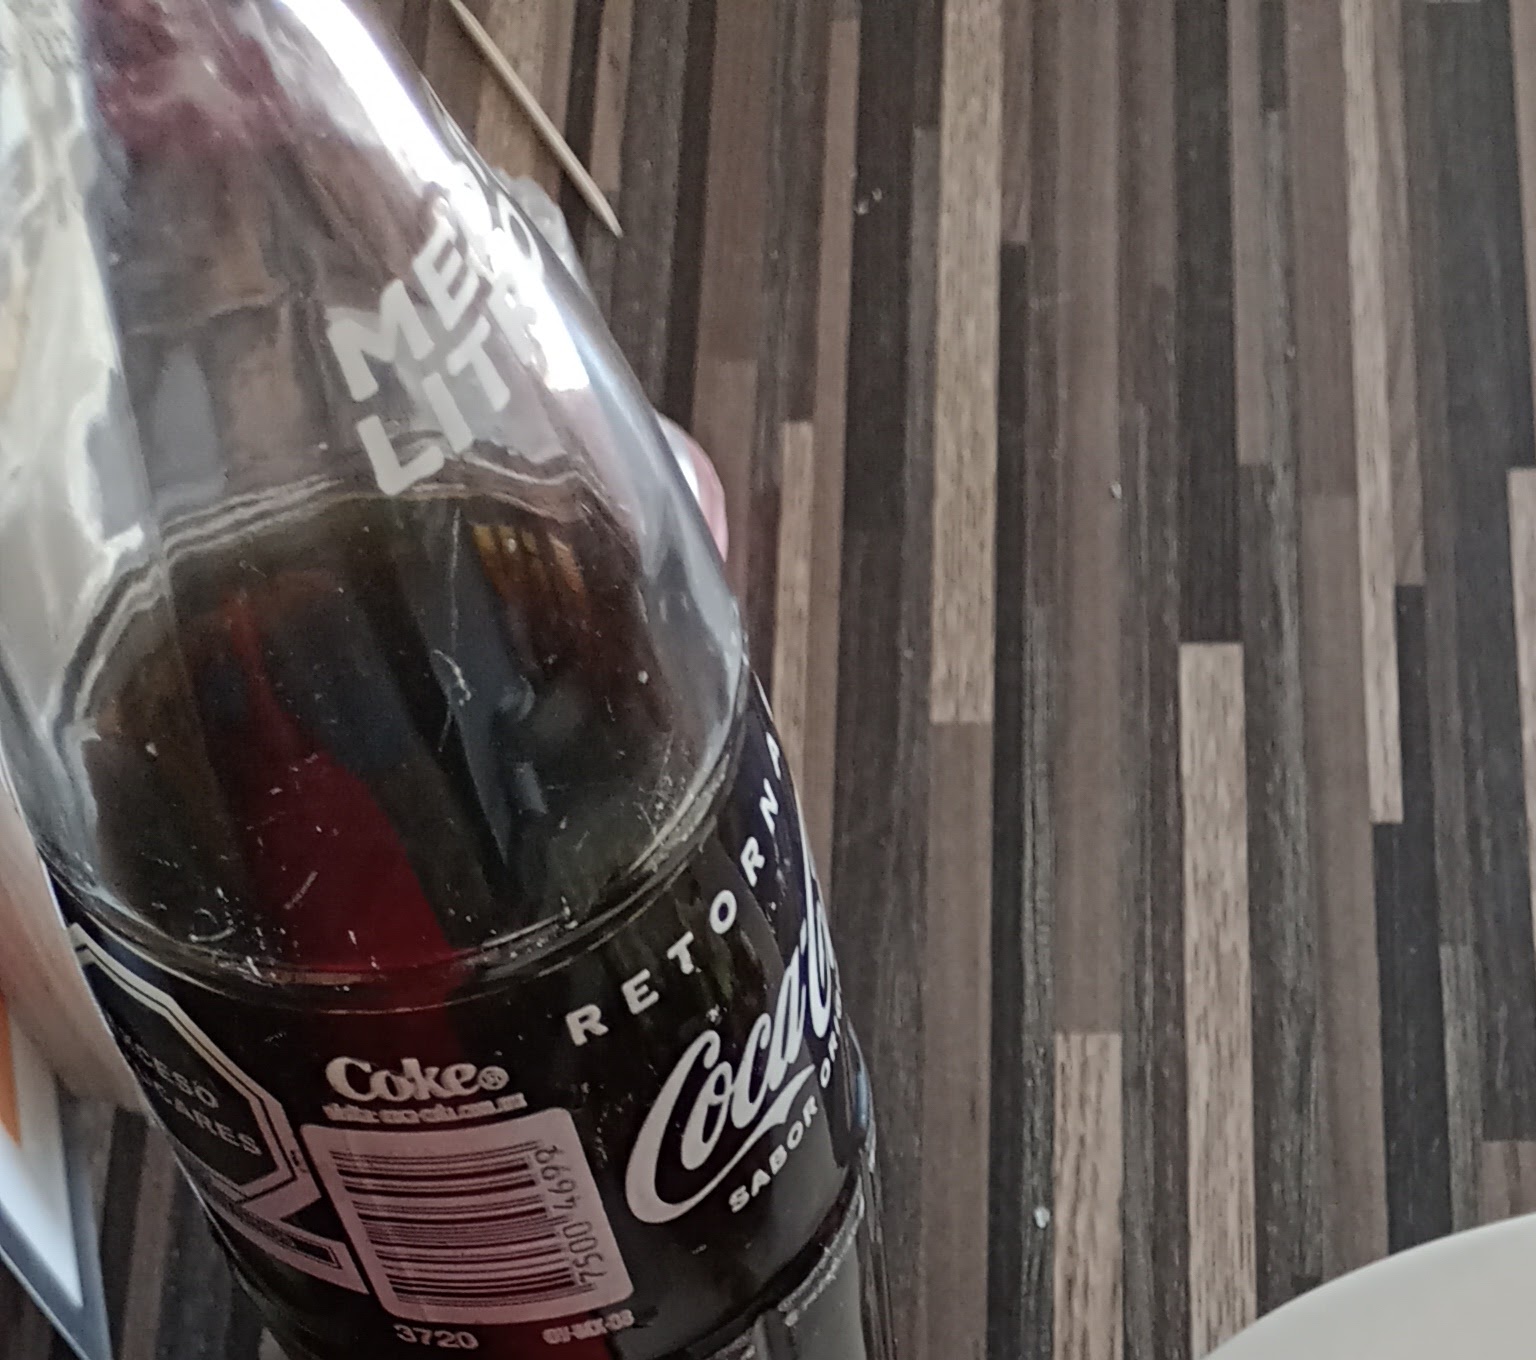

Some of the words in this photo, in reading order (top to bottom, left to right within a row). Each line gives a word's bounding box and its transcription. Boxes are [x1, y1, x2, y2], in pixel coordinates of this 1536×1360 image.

[565, 670, 781, 1046] RETORNA
[728, 1096, 819, 1214] SABOR
[393, 1323, 480, 1350] 3720
